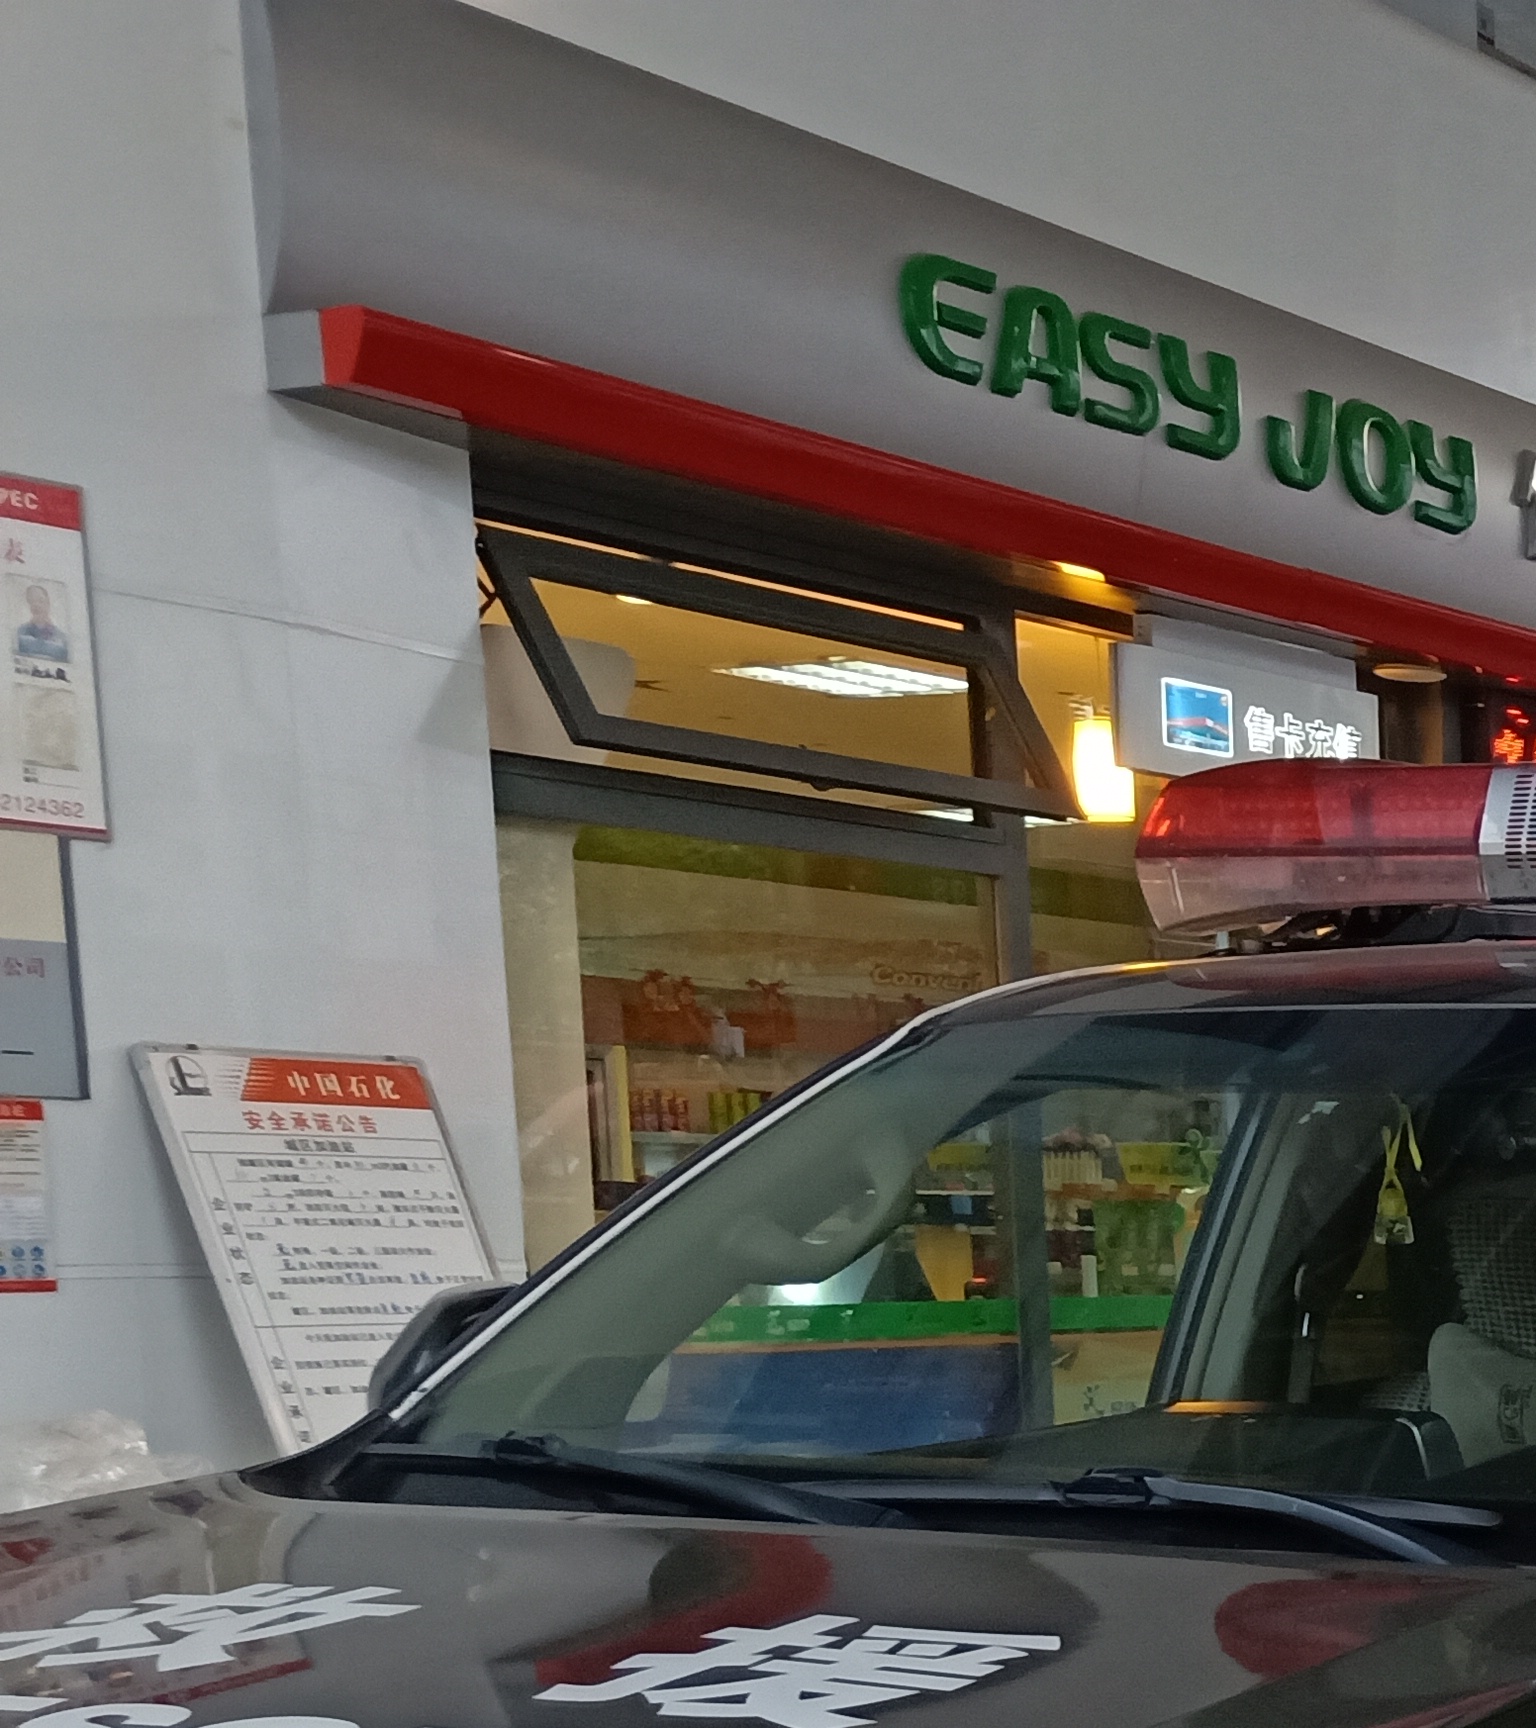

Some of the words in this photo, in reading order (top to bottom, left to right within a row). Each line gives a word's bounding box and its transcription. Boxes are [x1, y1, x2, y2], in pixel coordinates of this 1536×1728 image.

[898, 252, 1242, 461] EASY
[1266, 388, 1479, 536] JOY
[285, 1070, 402, 1100] 中国石化
[241, 1110, 379, 1134] 安全承诺公告
